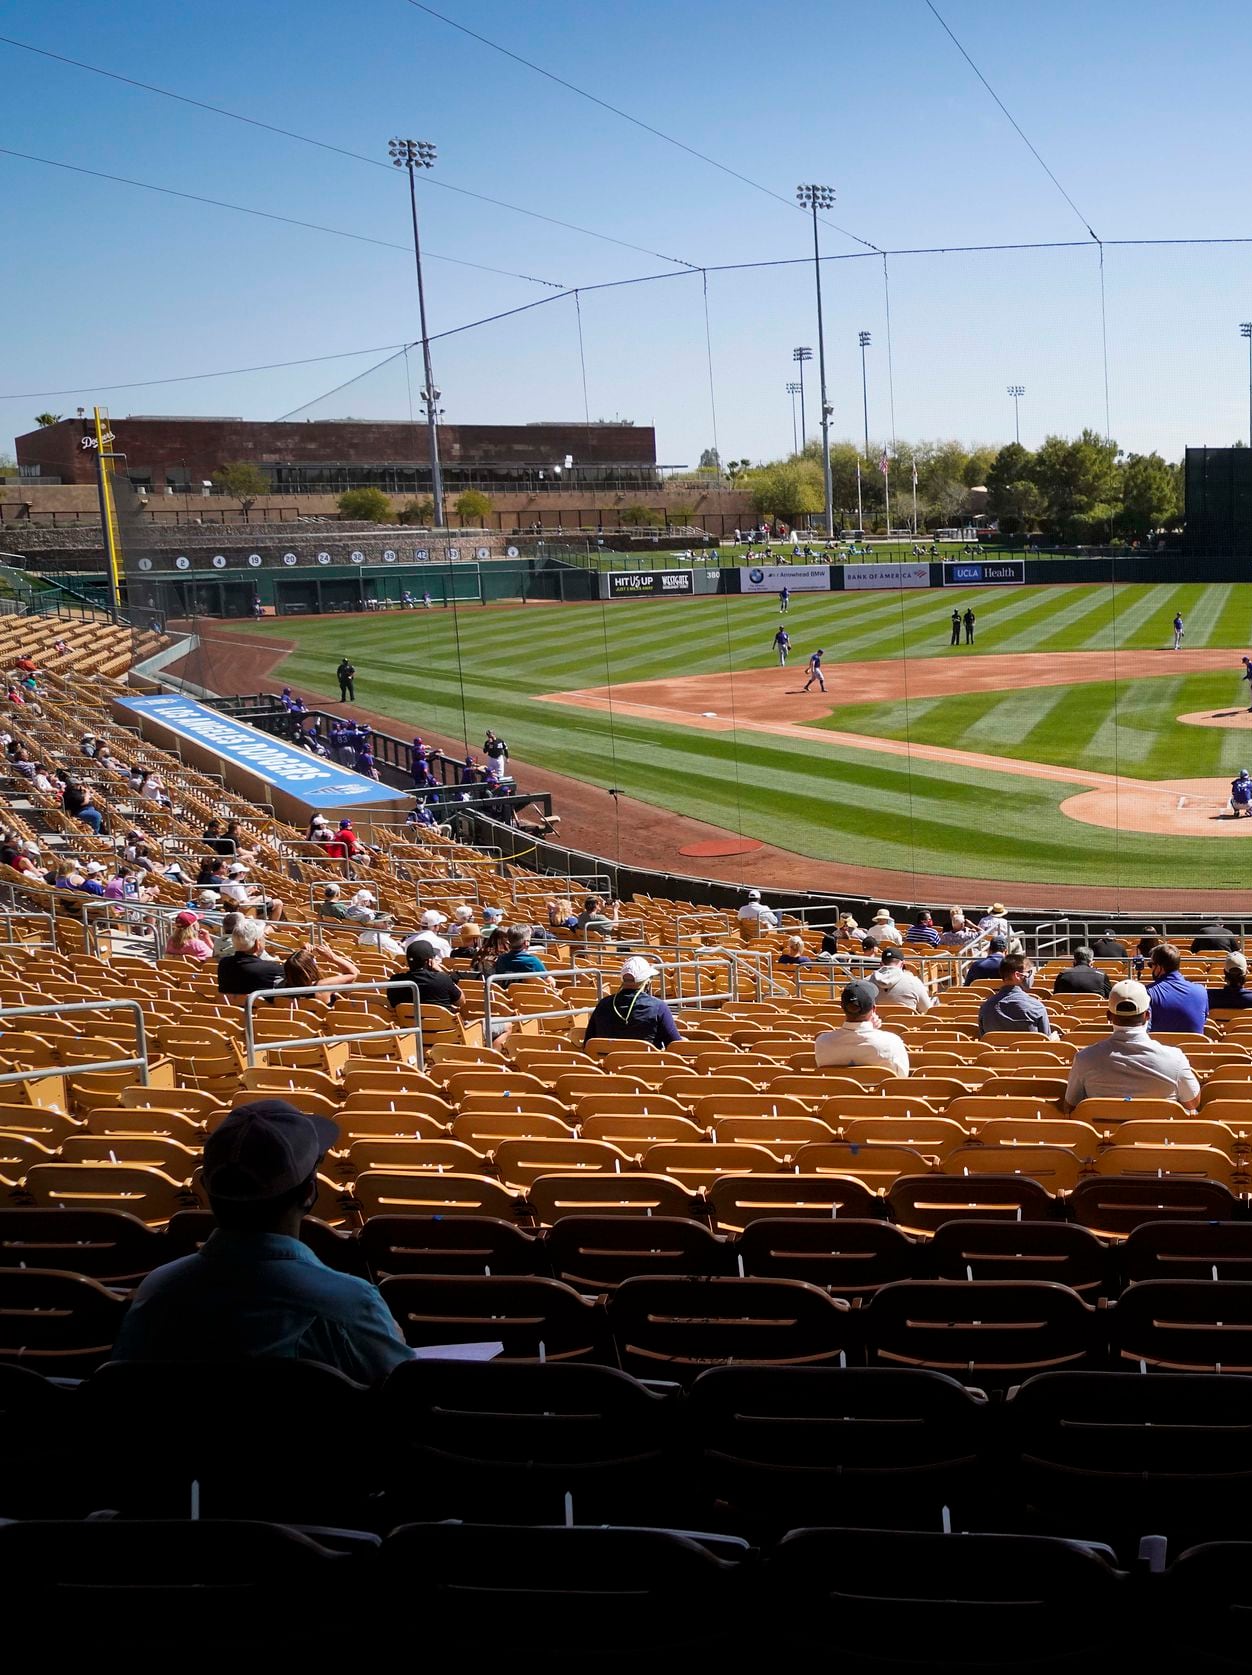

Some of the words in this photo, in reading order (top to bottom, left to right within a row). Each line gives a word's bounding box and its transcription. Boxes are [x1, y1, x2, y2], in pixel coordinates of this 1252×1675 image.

[286, 555, 295, 563] 20
[320, 554, 329, 562] 24
[353, 553, 362, 561] 32
[417, 551, 427, 559] 42
[252, 556, 259, 564] 19
[706, 571, 721, 579] 380
[957, 569, 979, 578] UCLA
[984, 567, 1015, 578] Health
[614, 577, 630, 587] HIT
[629, 576, 640, 588] US
[641, 577, 653, 586] UP
[662, 575, 689, 586] WESTGATE
[152, 706, 202, 718] LOS
[173, 718, 257, 745] ANGELES
[337, 735, 347, 743] 83
[226, 743, 331, 780] DODGERS
[126, 885, 135, 893] 17
